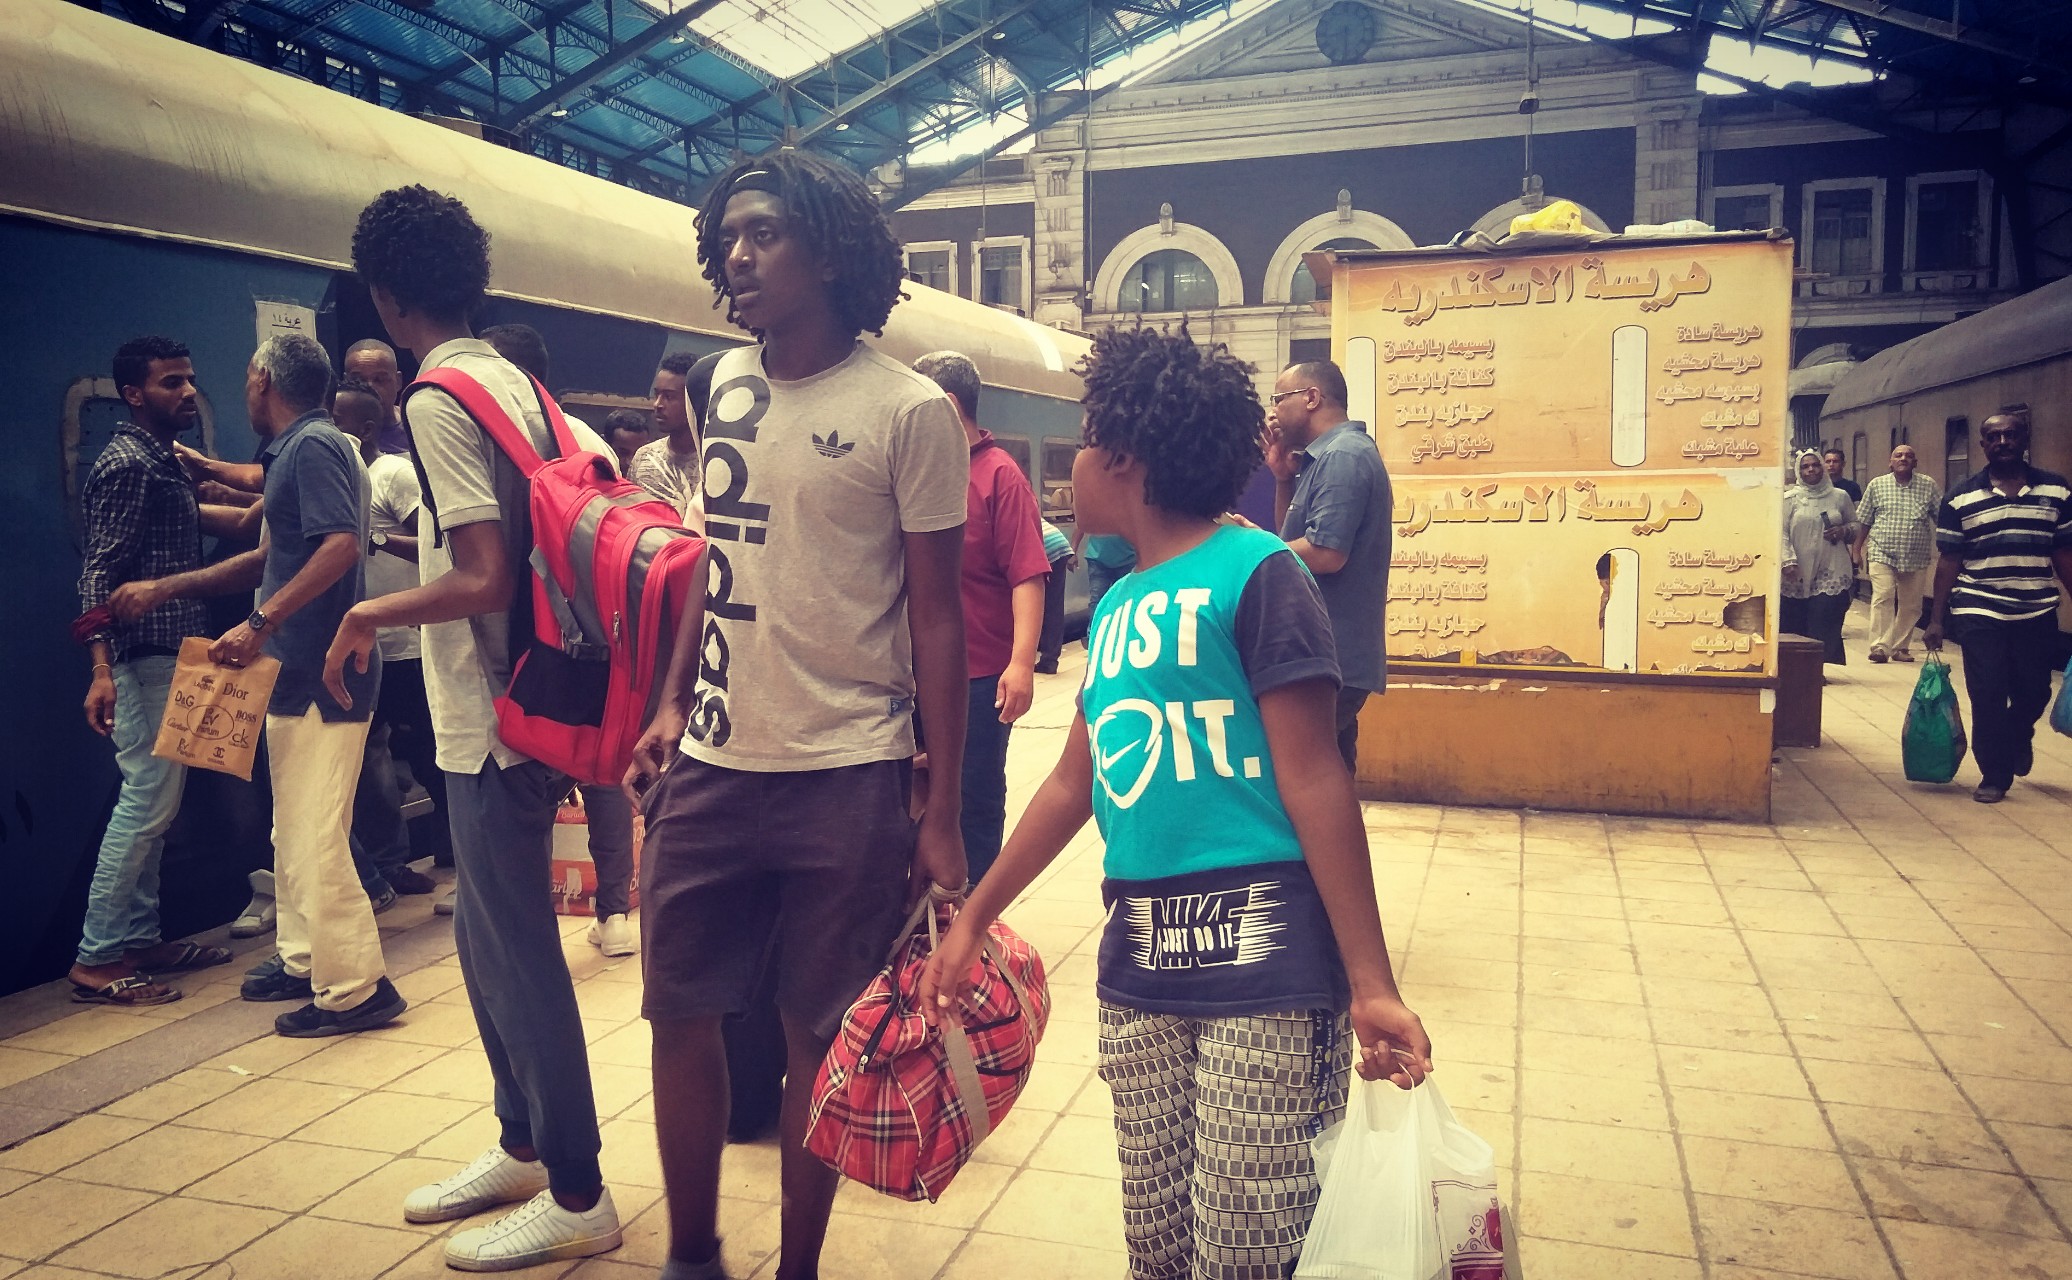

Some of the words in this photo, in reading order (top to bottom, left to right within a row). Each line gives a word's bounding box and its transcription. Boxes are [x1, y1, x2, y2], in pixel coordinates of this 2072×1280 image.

[1381, 263, 1574, 327] الاسكندريه
[1581, 256, 1712, 313] هريسة
[1677, 324, 1712, 343] سادة
[1713, 322, 1762, 345] هريسة
[1383, 339, 1445, 362] بالبندق
[1711, 351, 1762, 374] هريسة
[1663, 352, 1710, 376] محشيه
[1386, 371, 1448, 394] بالبندق
[1449, 366, 1495, 388] كنافة
[1655, 381, 1703, 405] محشيه
[1705, 383, 1760, 402] بسبوسه
[1395, 404, 1434, 427] بندق
[1436, 401, 1493, 427] حجازيه
[1700, 407, 1743, 431] مشبك
[1410, 431, 1457, 463] شرقي
[1457, 432, 1493, 457] طبق
[1682, 436, 1724, 460] مشبك
[1724, 437, 1759, 460] علبة
[1391, 482, 1566, 537] الاسكندري
[1573, 479, 1702, 537] هريسة
[689, 374, 771, 748] adidas
[1390, 550, 1438, 574] بالبند
[1668, 549, 1703, 567] سادة
[1703, 549, 1754, 572] هريسة
[1441, 580, 1487, 601] كنافة
[1654, 578, 1701, 600] محشيه
[1703, 578, 1753, 601] هريسة
[1388, 611, 1427, 638] بندق
[1428, 612, 1486, 639] حجازيه
[1647, 605, 1695, 629] محشيه
[1083, 588, 1212, 690] JUST
[1691, 633, 1734, 656] مشبك
[222, 682, 250, 701] Dior
[235, 709, 258, 724] BOSS
[1165, 699, 1261, 781] IT.
[1161, 927, 1189, 953] JUST
[1193, 924, 1214, 951] DO
[1218, 922, 1233, 949] IT
